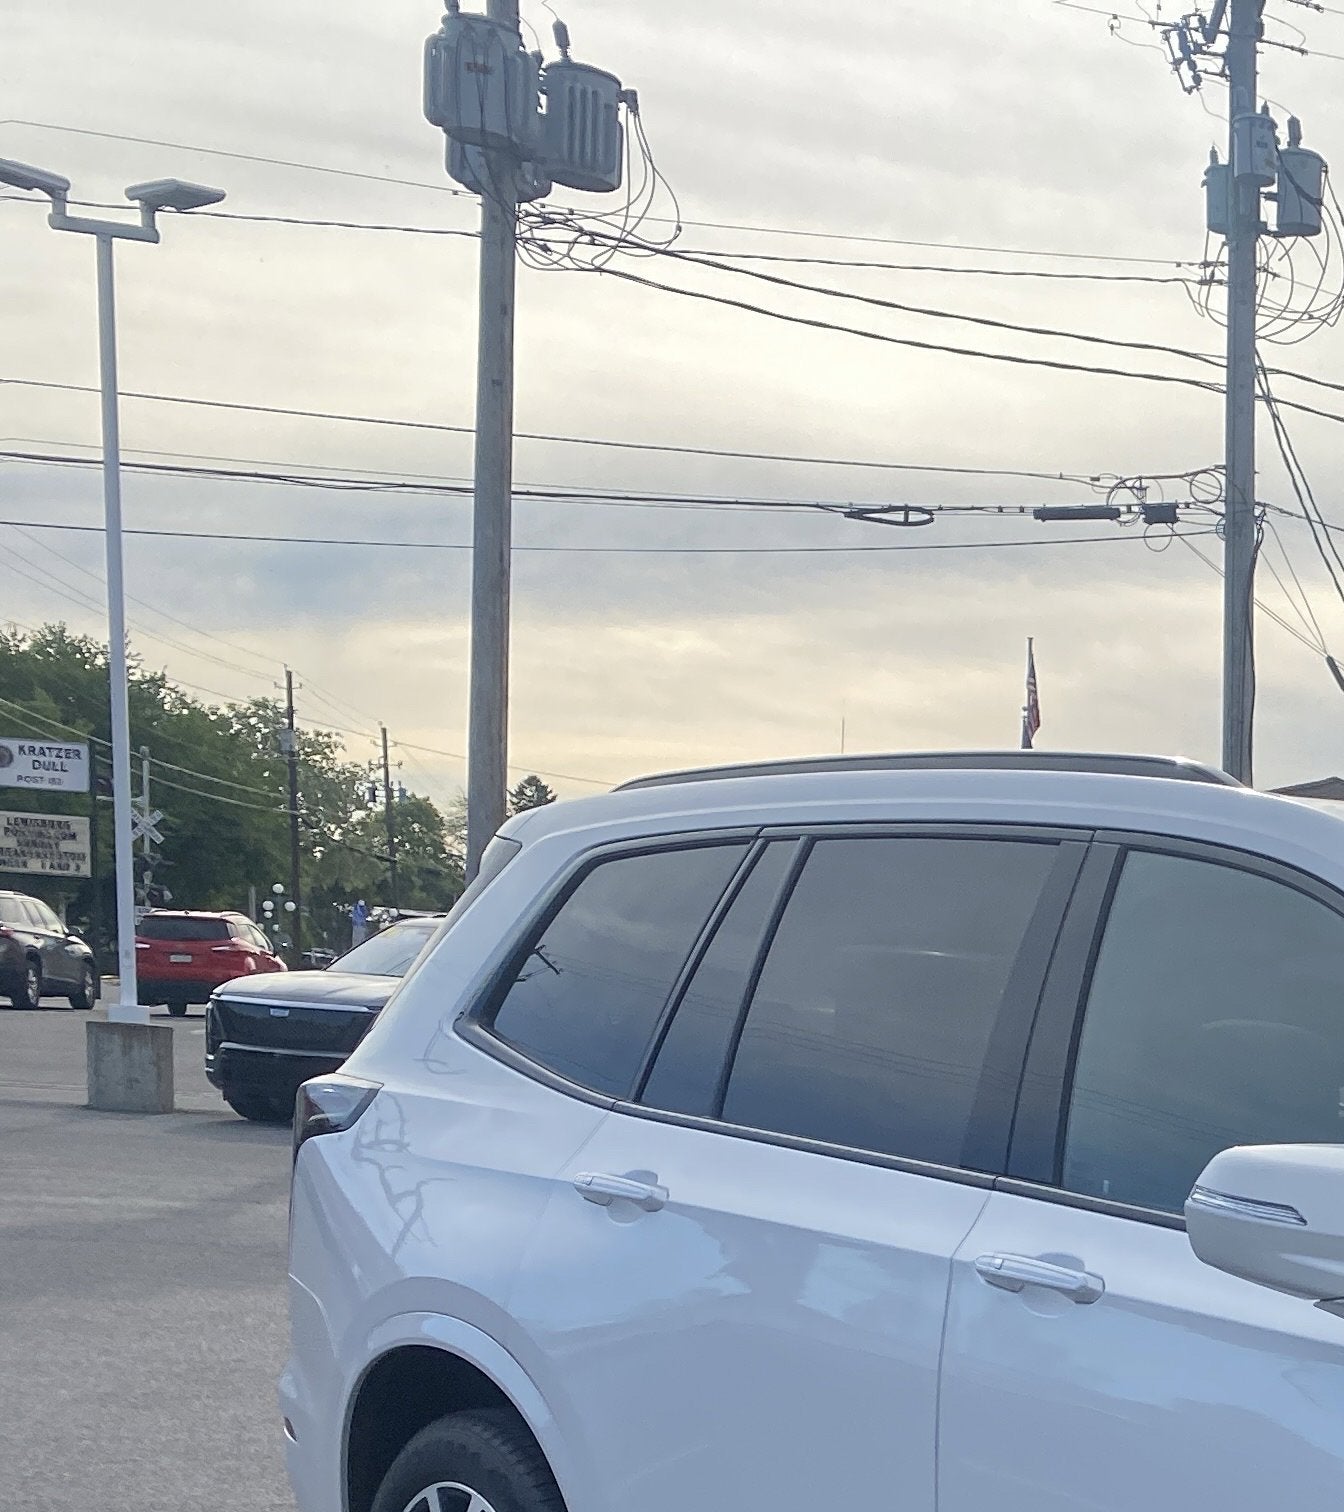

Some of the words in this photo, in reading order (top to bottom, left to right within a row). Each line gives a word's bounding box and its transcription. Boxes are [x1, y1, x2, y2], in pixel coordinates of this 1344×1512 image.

[18, 744, 82, 760] KRATZER
[32, 760, 69, 772] DULL
[17, 774, 44, 784] POST
